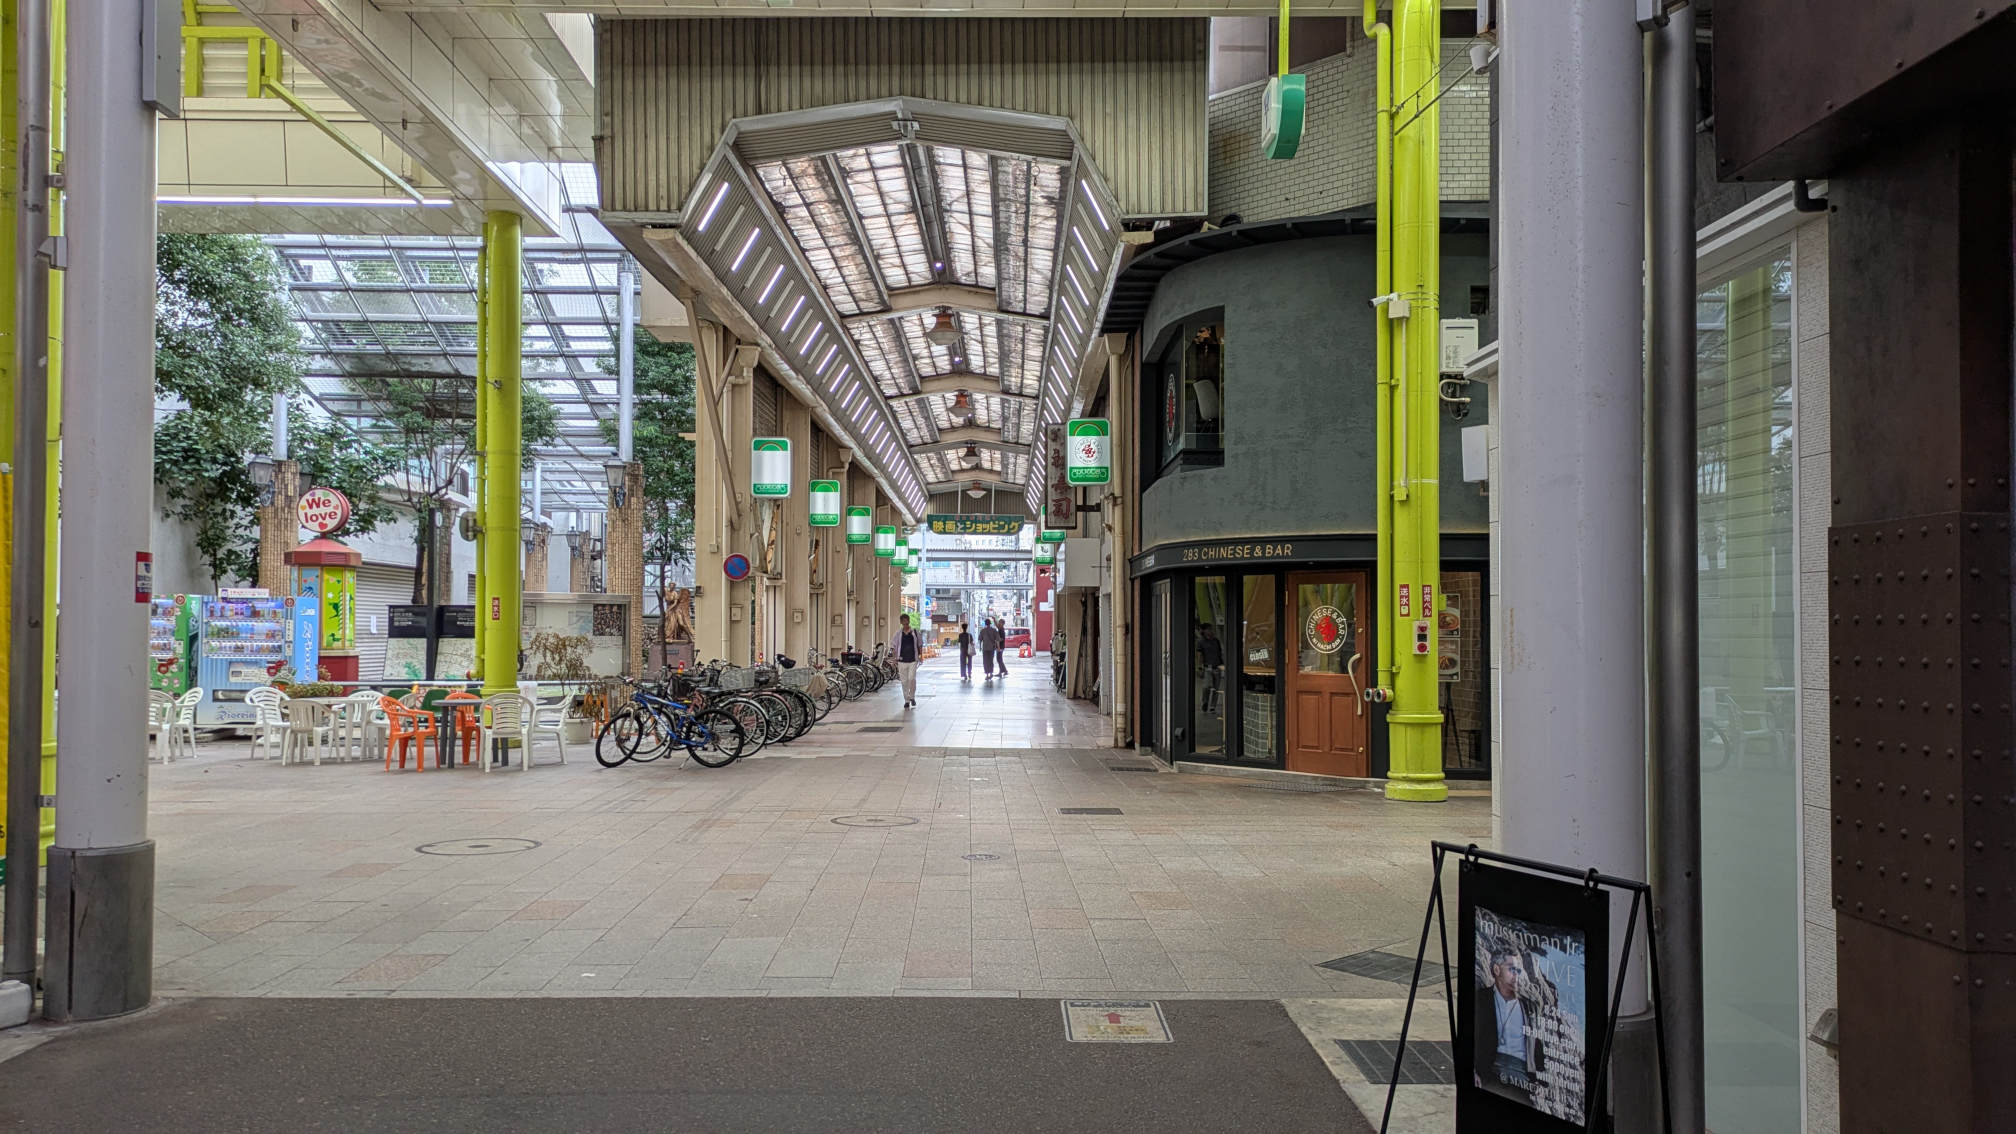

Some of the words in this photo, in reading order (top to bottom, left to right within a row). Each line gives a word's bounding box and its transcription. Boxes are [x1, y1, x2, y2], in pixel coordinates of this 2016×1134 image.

[306, 497, 332, 510] We
[304, 511, 338, 524] love
[932, 520, 1021, 533] 映画とショッピング
[1182, 549, 1199, 561] 283
[1201, 545, 1251, 560] CHINESE
[1253, 545, 1263, 557] &
[1265, 543, 1293, 557] BAR
[1423, 586, 1432, 617] 非常ベル
[1308, 608, 1333, 635] CHINESE
[1331, 611, 1339, 620] &
[1335, 616, 1345, 635] BAR
[1536, 958, 1577, 989] LIVE
[1543, 1046, 1580, 1066] entrance
[1544, 1058, 1580, 1079] 5000yen
